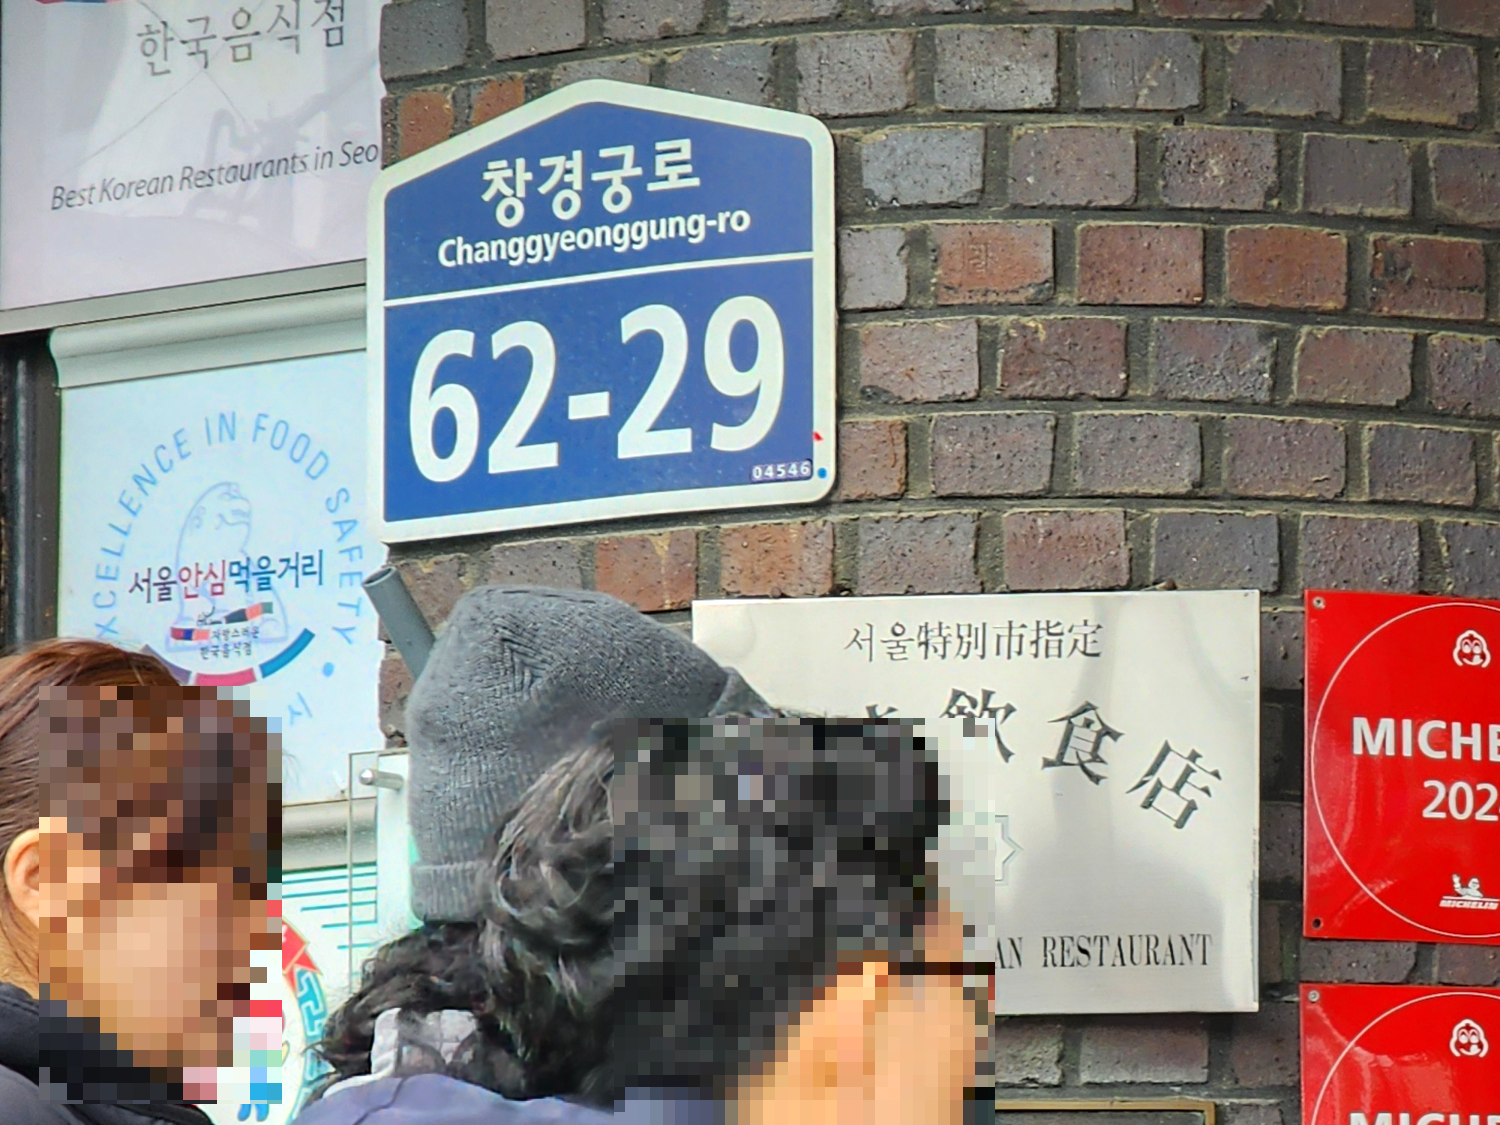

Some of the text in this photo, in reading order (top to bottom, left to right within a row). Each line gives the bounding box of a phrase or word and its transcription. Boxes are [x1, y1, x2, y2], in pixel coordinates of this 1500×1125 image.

[136, 0, 345, 76] 한국음식점
[51, 184, 96, 210] Best
[99, 172, 173, 203] Korean
[179, 152, 307, 191] Restaurants
[314, 146, 333, 171] in
[481, 138, 700, 227] 창경궁로
[438, 210, 751, 267] Changgyeonggung-ro
[409, 295, 785, 483] 62-29
[752, 462, 811, 480] 04546
[93, 411, 364, 645] XCELLENCE IN FOOD SAFETY
[844, 620, 1103, 662] 서울特別市指定
[1439, 899, 1500, 911] MICHELIN
[1042, 933, 1213, 968] RESTAURANT
